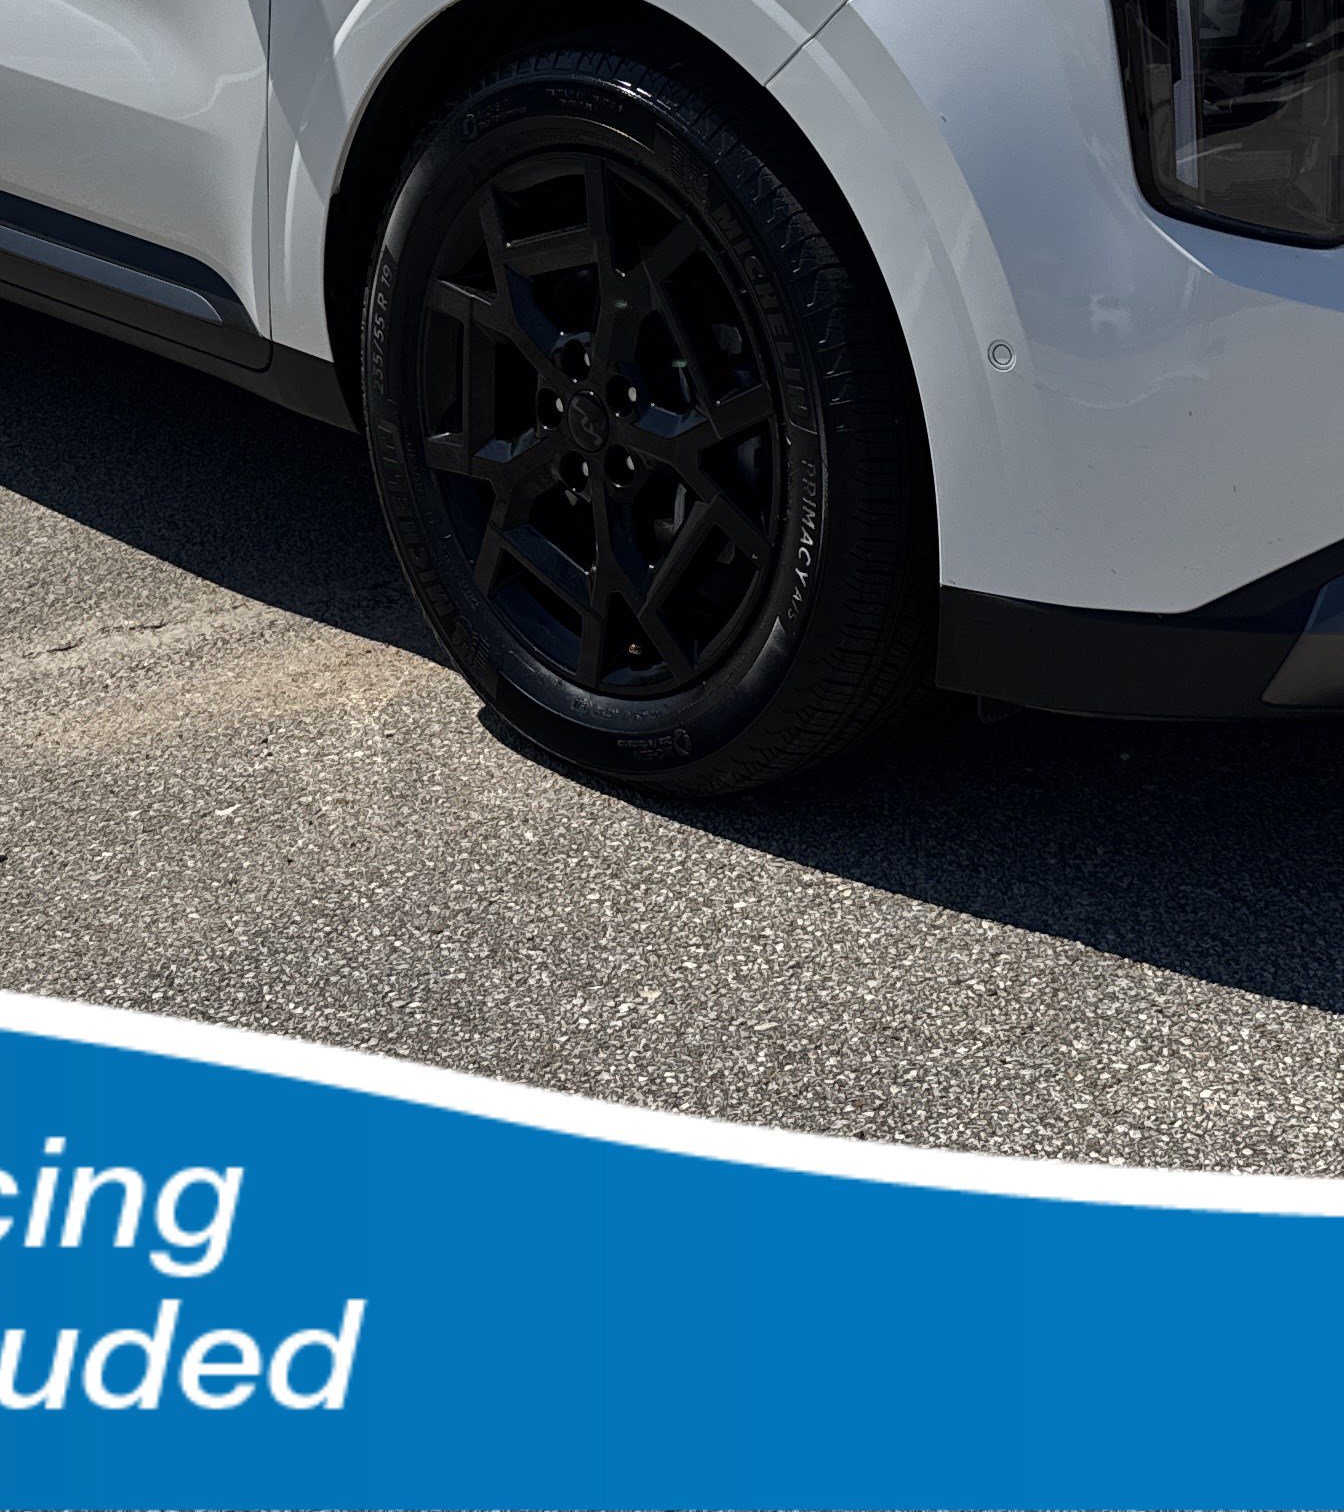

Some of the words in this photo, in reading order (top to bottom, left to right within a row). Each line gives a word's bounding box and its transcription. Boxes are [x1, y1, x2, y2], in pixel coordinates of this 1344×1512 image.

[372, 312, 386, 396] 235/55
[376, 291, 389, 312] R
[712, 204, 810, 416] MICHELIN
[794, 459, 818, 588] PRIMACY
